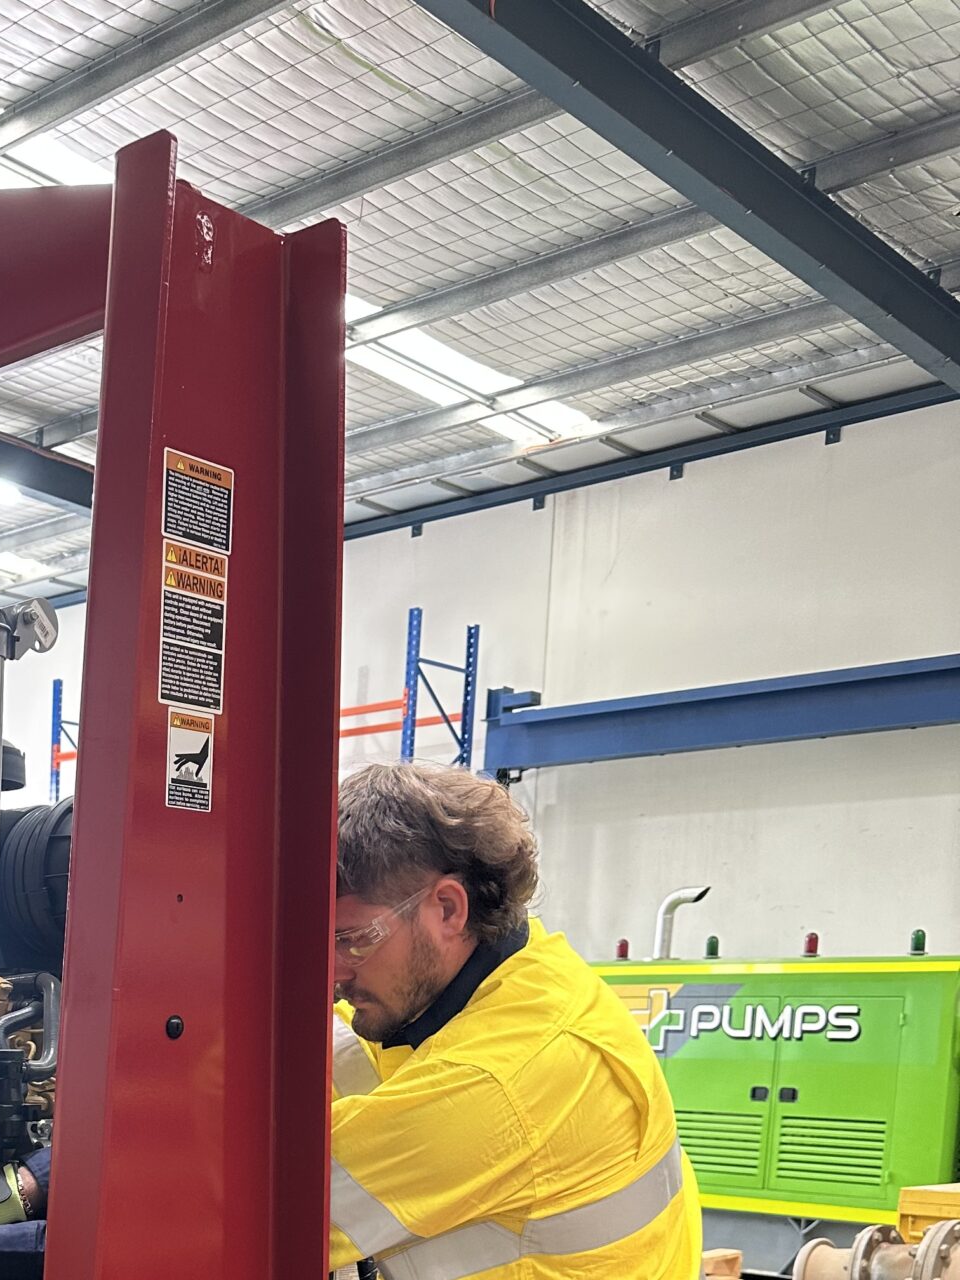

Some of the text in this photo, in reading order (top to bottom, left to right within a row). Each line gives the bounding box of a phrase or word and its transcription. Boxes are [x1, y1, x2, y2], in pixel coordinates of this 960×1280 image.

[188, 463, 222, 481] WARNING
[178, 548, 223, 576] ¡ALERTA!
[176, 571, 223, 599] WARNING
[180, 718, 210, 730] WARNING
[690, 1004, 861, 1041] PUMPS
